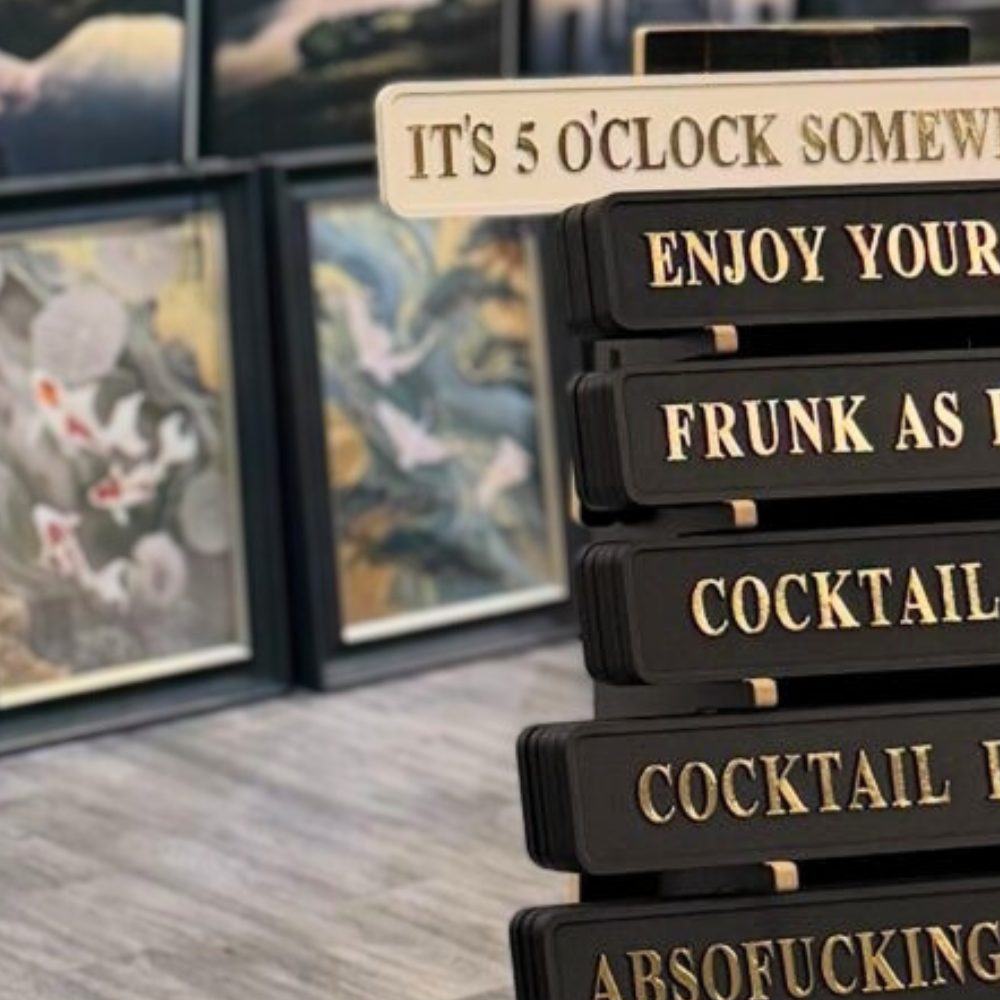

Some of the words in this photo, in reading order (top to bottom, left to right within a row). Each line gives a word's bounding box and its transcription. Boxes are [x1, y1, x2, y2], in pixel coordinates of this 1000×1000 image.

[406, 114, 496, 180] IT'S
[515, 123, 540, 176] 5
[557, 110, 782, 173] O'CLOCK
[643, 225, 826, 289] ENJOY
[662, 393, 874, 463] FRUNK
[895, 390, 964, 451] AS
[690, 561, 1000, 638] COCKTAIL
[636, 743, 951, 824] COCKTAIL
